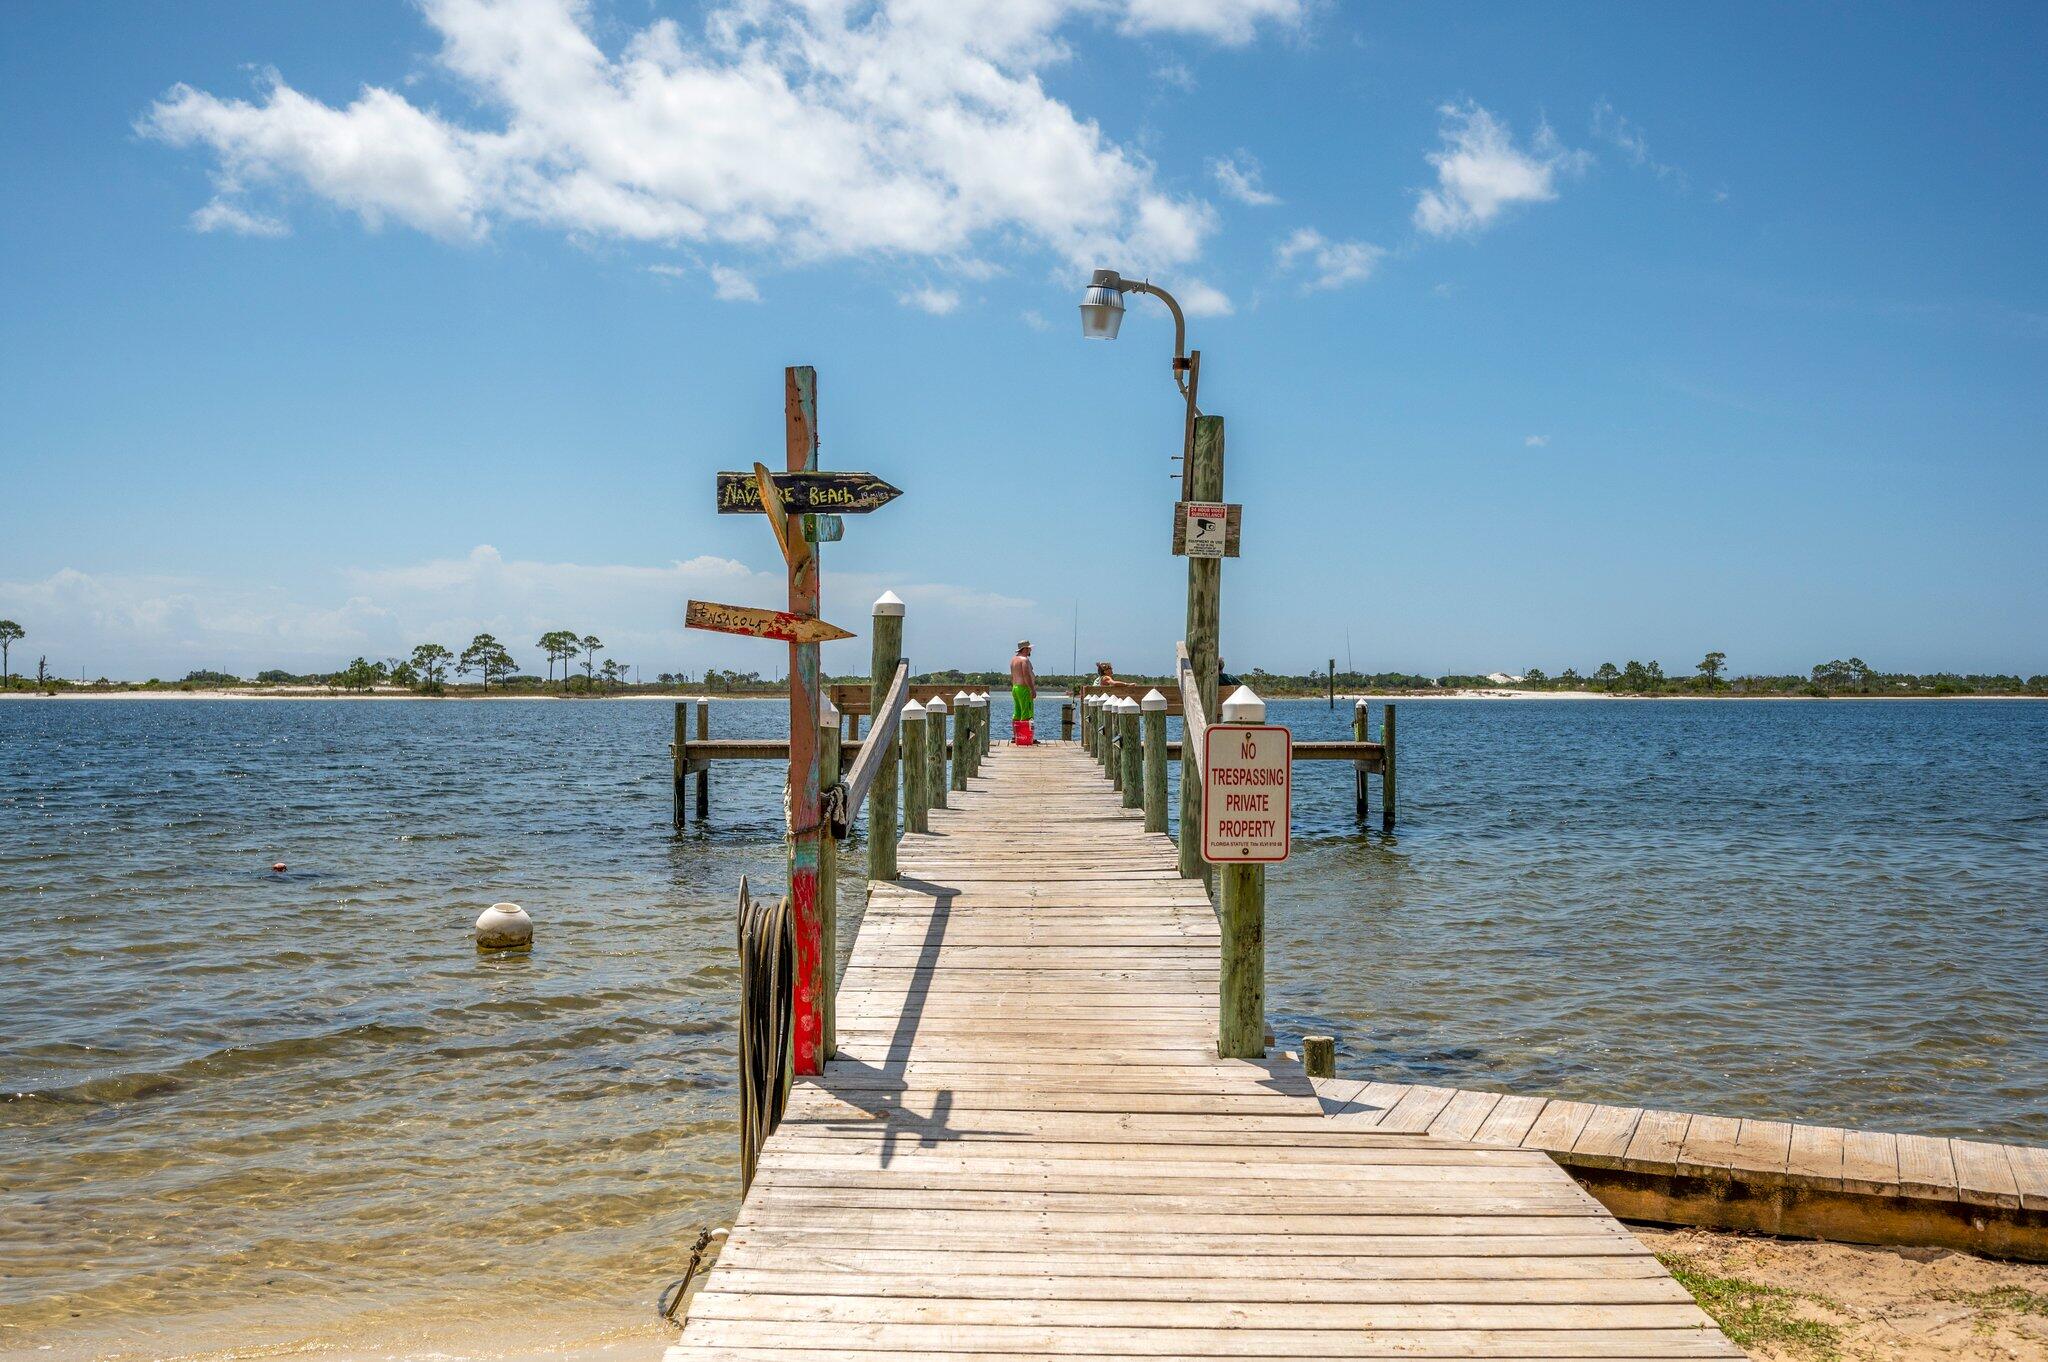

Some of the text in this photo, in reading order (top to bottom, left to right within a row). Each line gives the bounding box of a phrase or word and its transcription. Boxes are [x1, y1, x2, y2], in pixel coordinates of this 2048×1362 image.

[722, 483, 795, 507] NAVARE
[1241, 742, 1257, 760] NO
[1212, 768, 1284, 786] TRESPASSING
[1226, 794, 1269, 812] PRIVATE
[1219, 820, 1276, 838] PROPERTY
